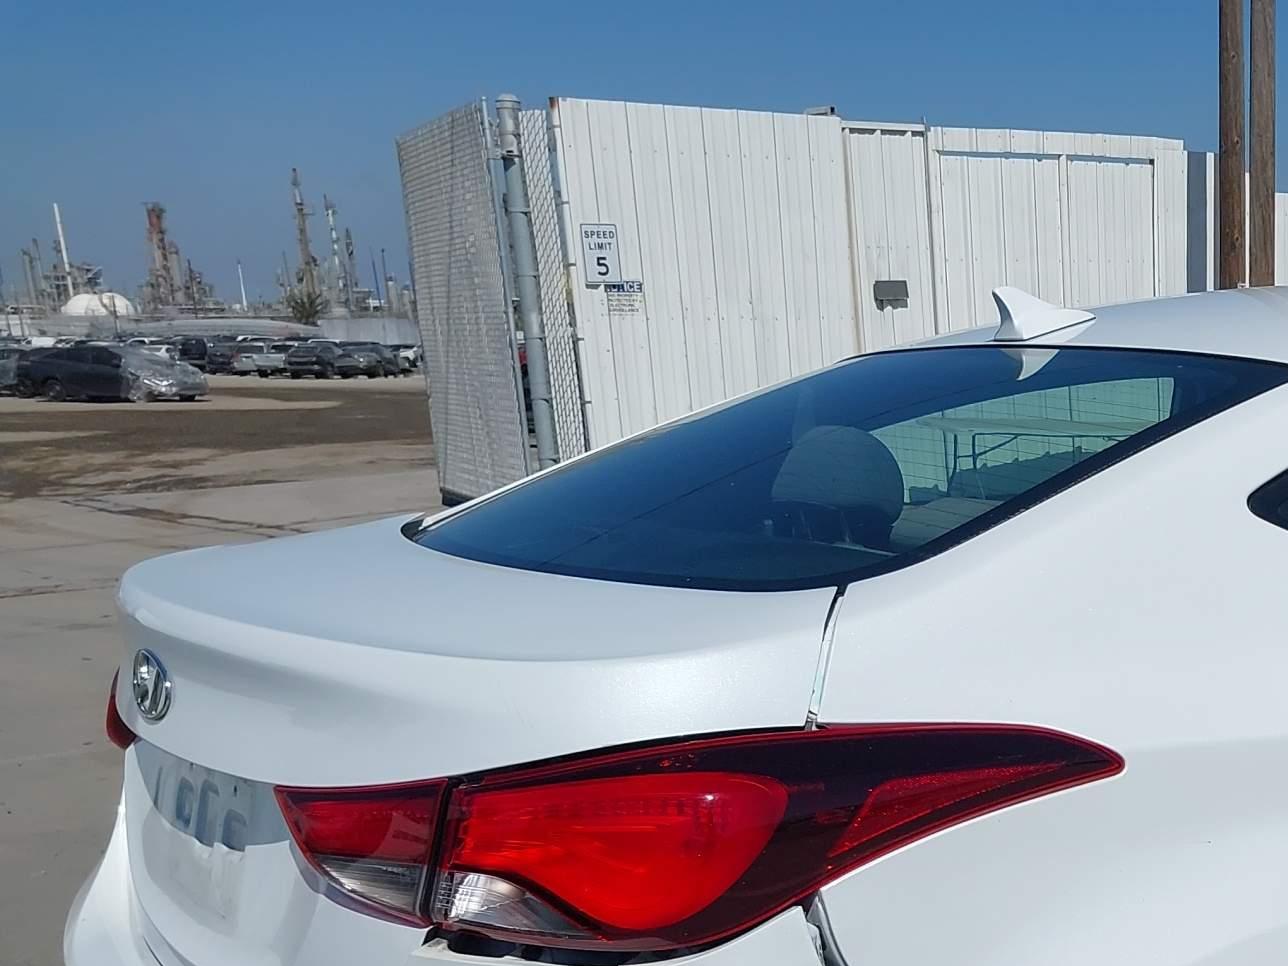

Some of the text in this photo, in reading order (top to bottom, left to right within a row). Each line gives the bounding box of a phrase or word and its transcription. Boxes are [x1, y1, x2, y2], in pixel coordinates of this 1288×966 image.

[583, 230, 615, 239] SPEED
[588, 241, 612, 251] LIMIT
[596, 256, 610, 276] 5
